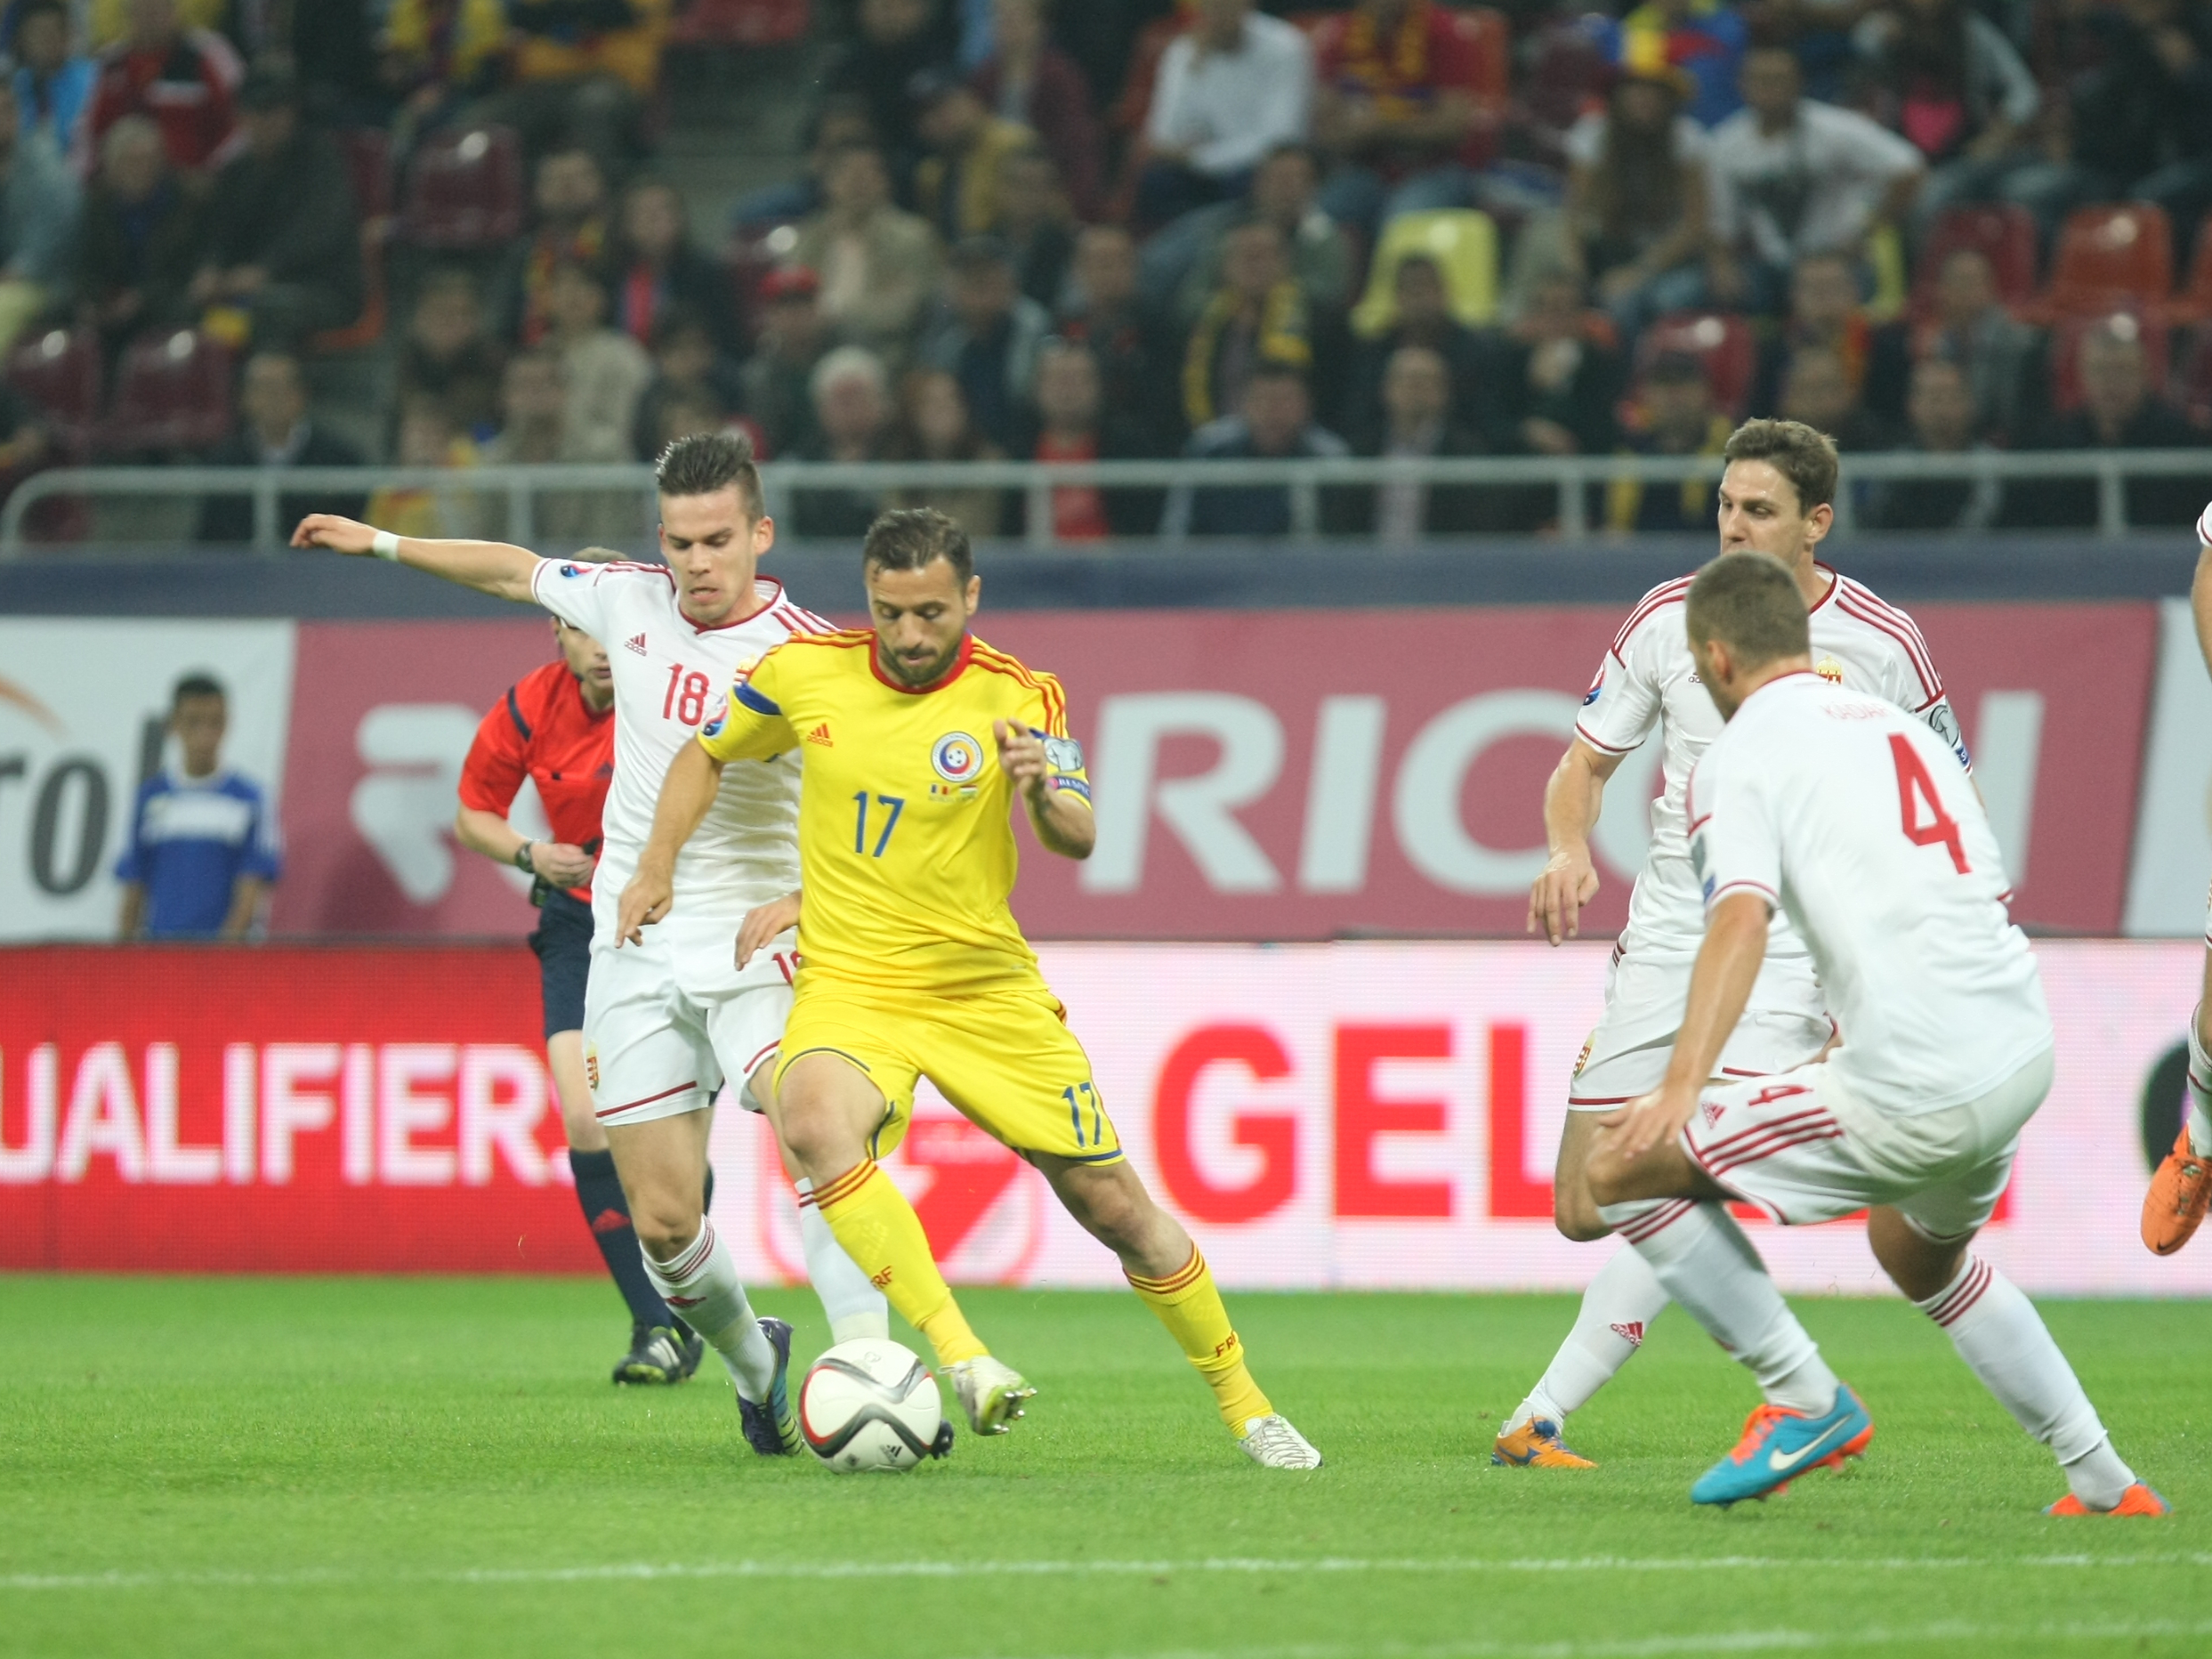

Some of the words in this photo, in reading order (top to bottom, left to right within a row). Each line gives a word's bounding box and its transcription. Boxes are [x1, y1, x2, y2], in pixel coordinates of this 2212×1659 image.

[662, 662, 710, 726] 18
[852, 789, 906, 858] 17
[1078, 687, 2045, 901] RIC
[1887, 732, 1973, 875] 4
[0, 1040, 576, 1186] UALIFIER
[1061, 1081, 1101, 1148] 17
